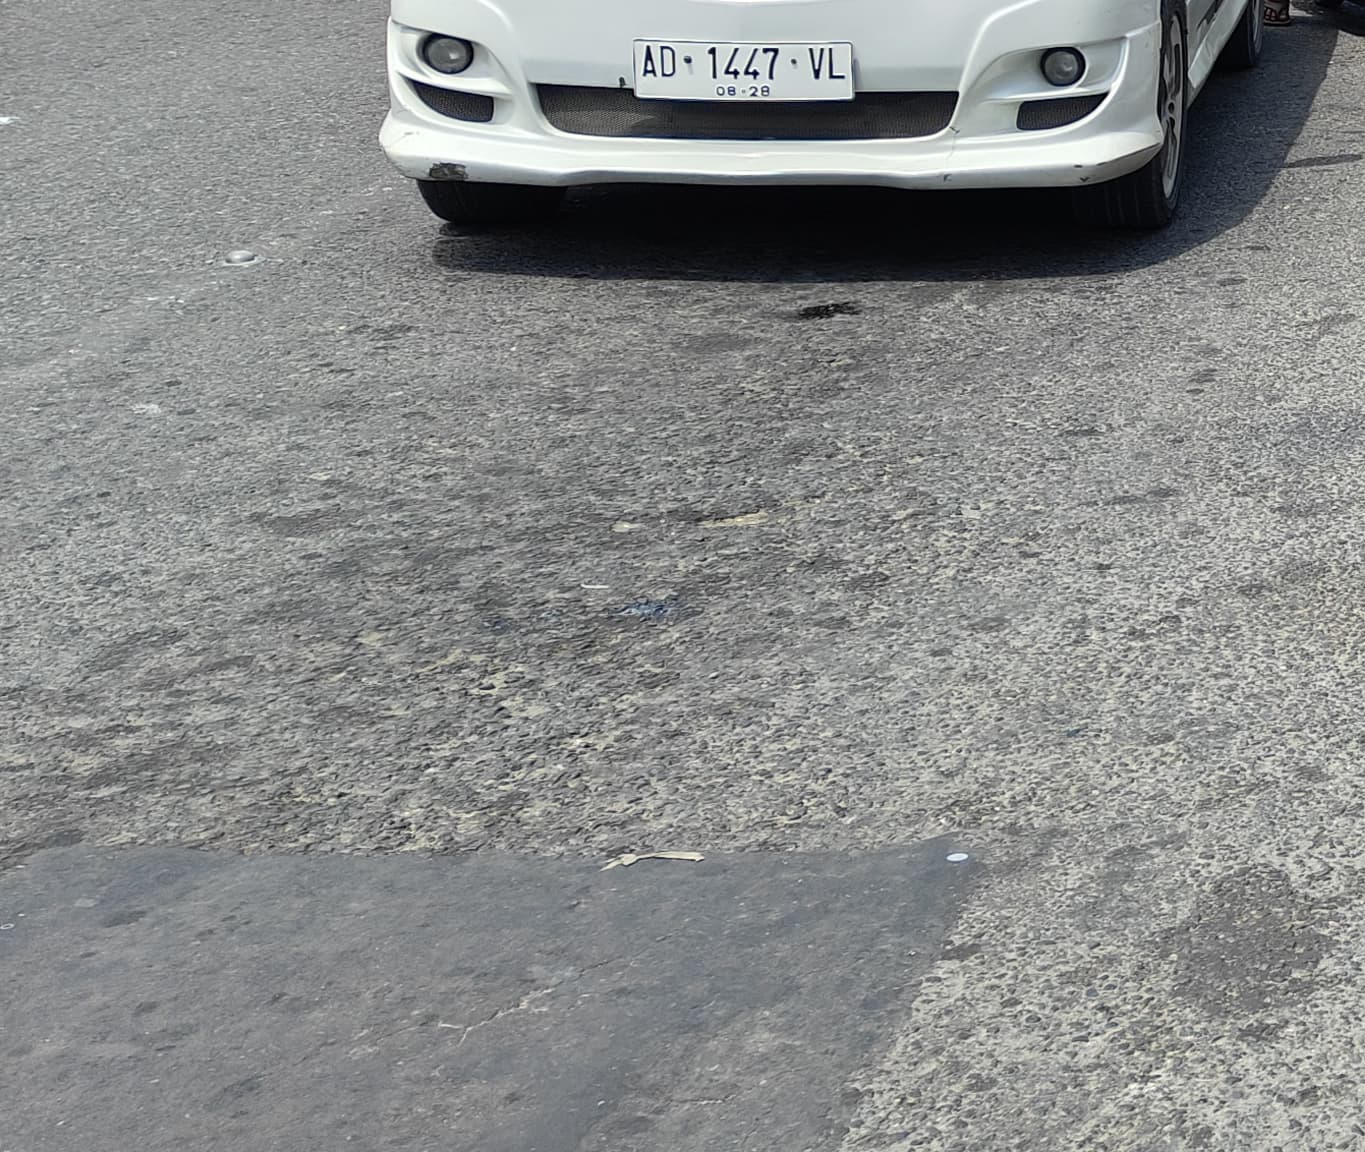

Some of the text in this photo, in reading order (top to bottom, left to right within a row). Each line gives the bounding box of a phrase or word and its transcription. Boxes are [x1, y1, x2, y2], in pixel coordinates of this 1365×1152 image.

[643, 45, 846, 81] AD 1447 VL
